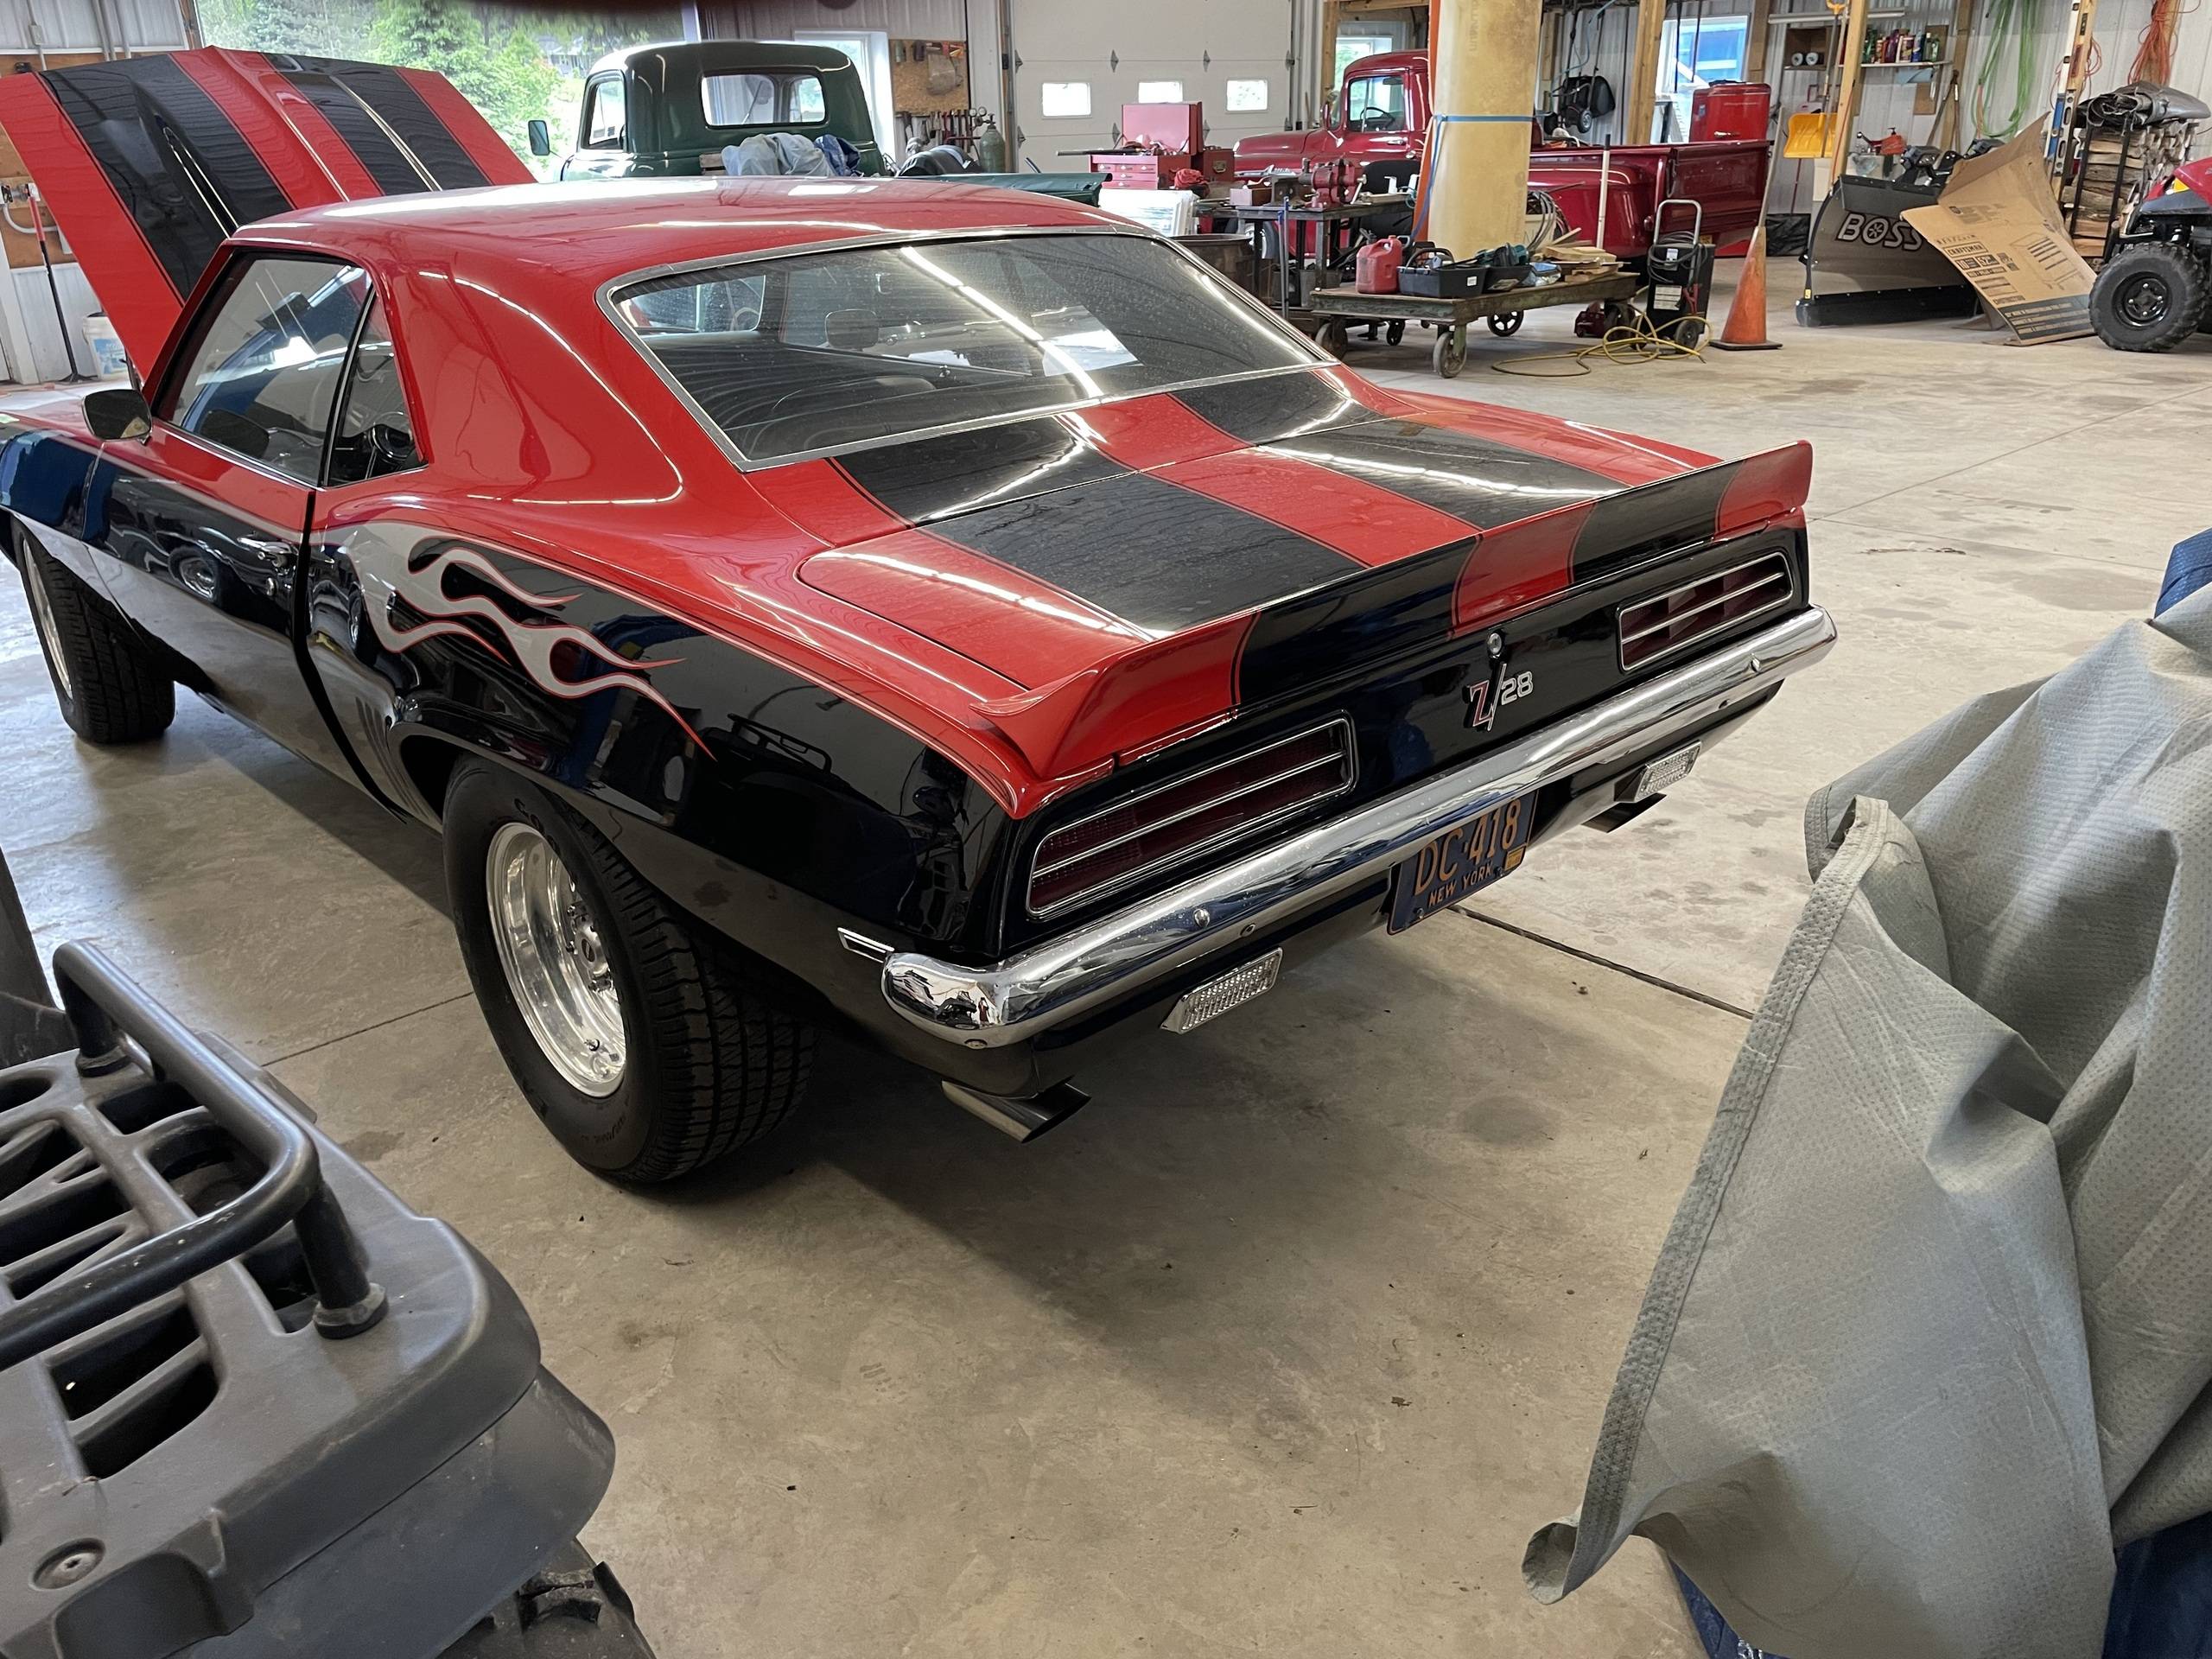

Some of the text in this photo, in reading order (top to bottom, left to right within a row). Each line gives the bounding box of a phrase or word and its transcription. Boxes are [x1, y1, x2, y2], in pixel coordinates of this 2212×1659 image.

[1837, 213, 1923, 251] BOSS
[1428, 880, 1458, 908] NEW
[1463, 859, 1494, 891] YORK
